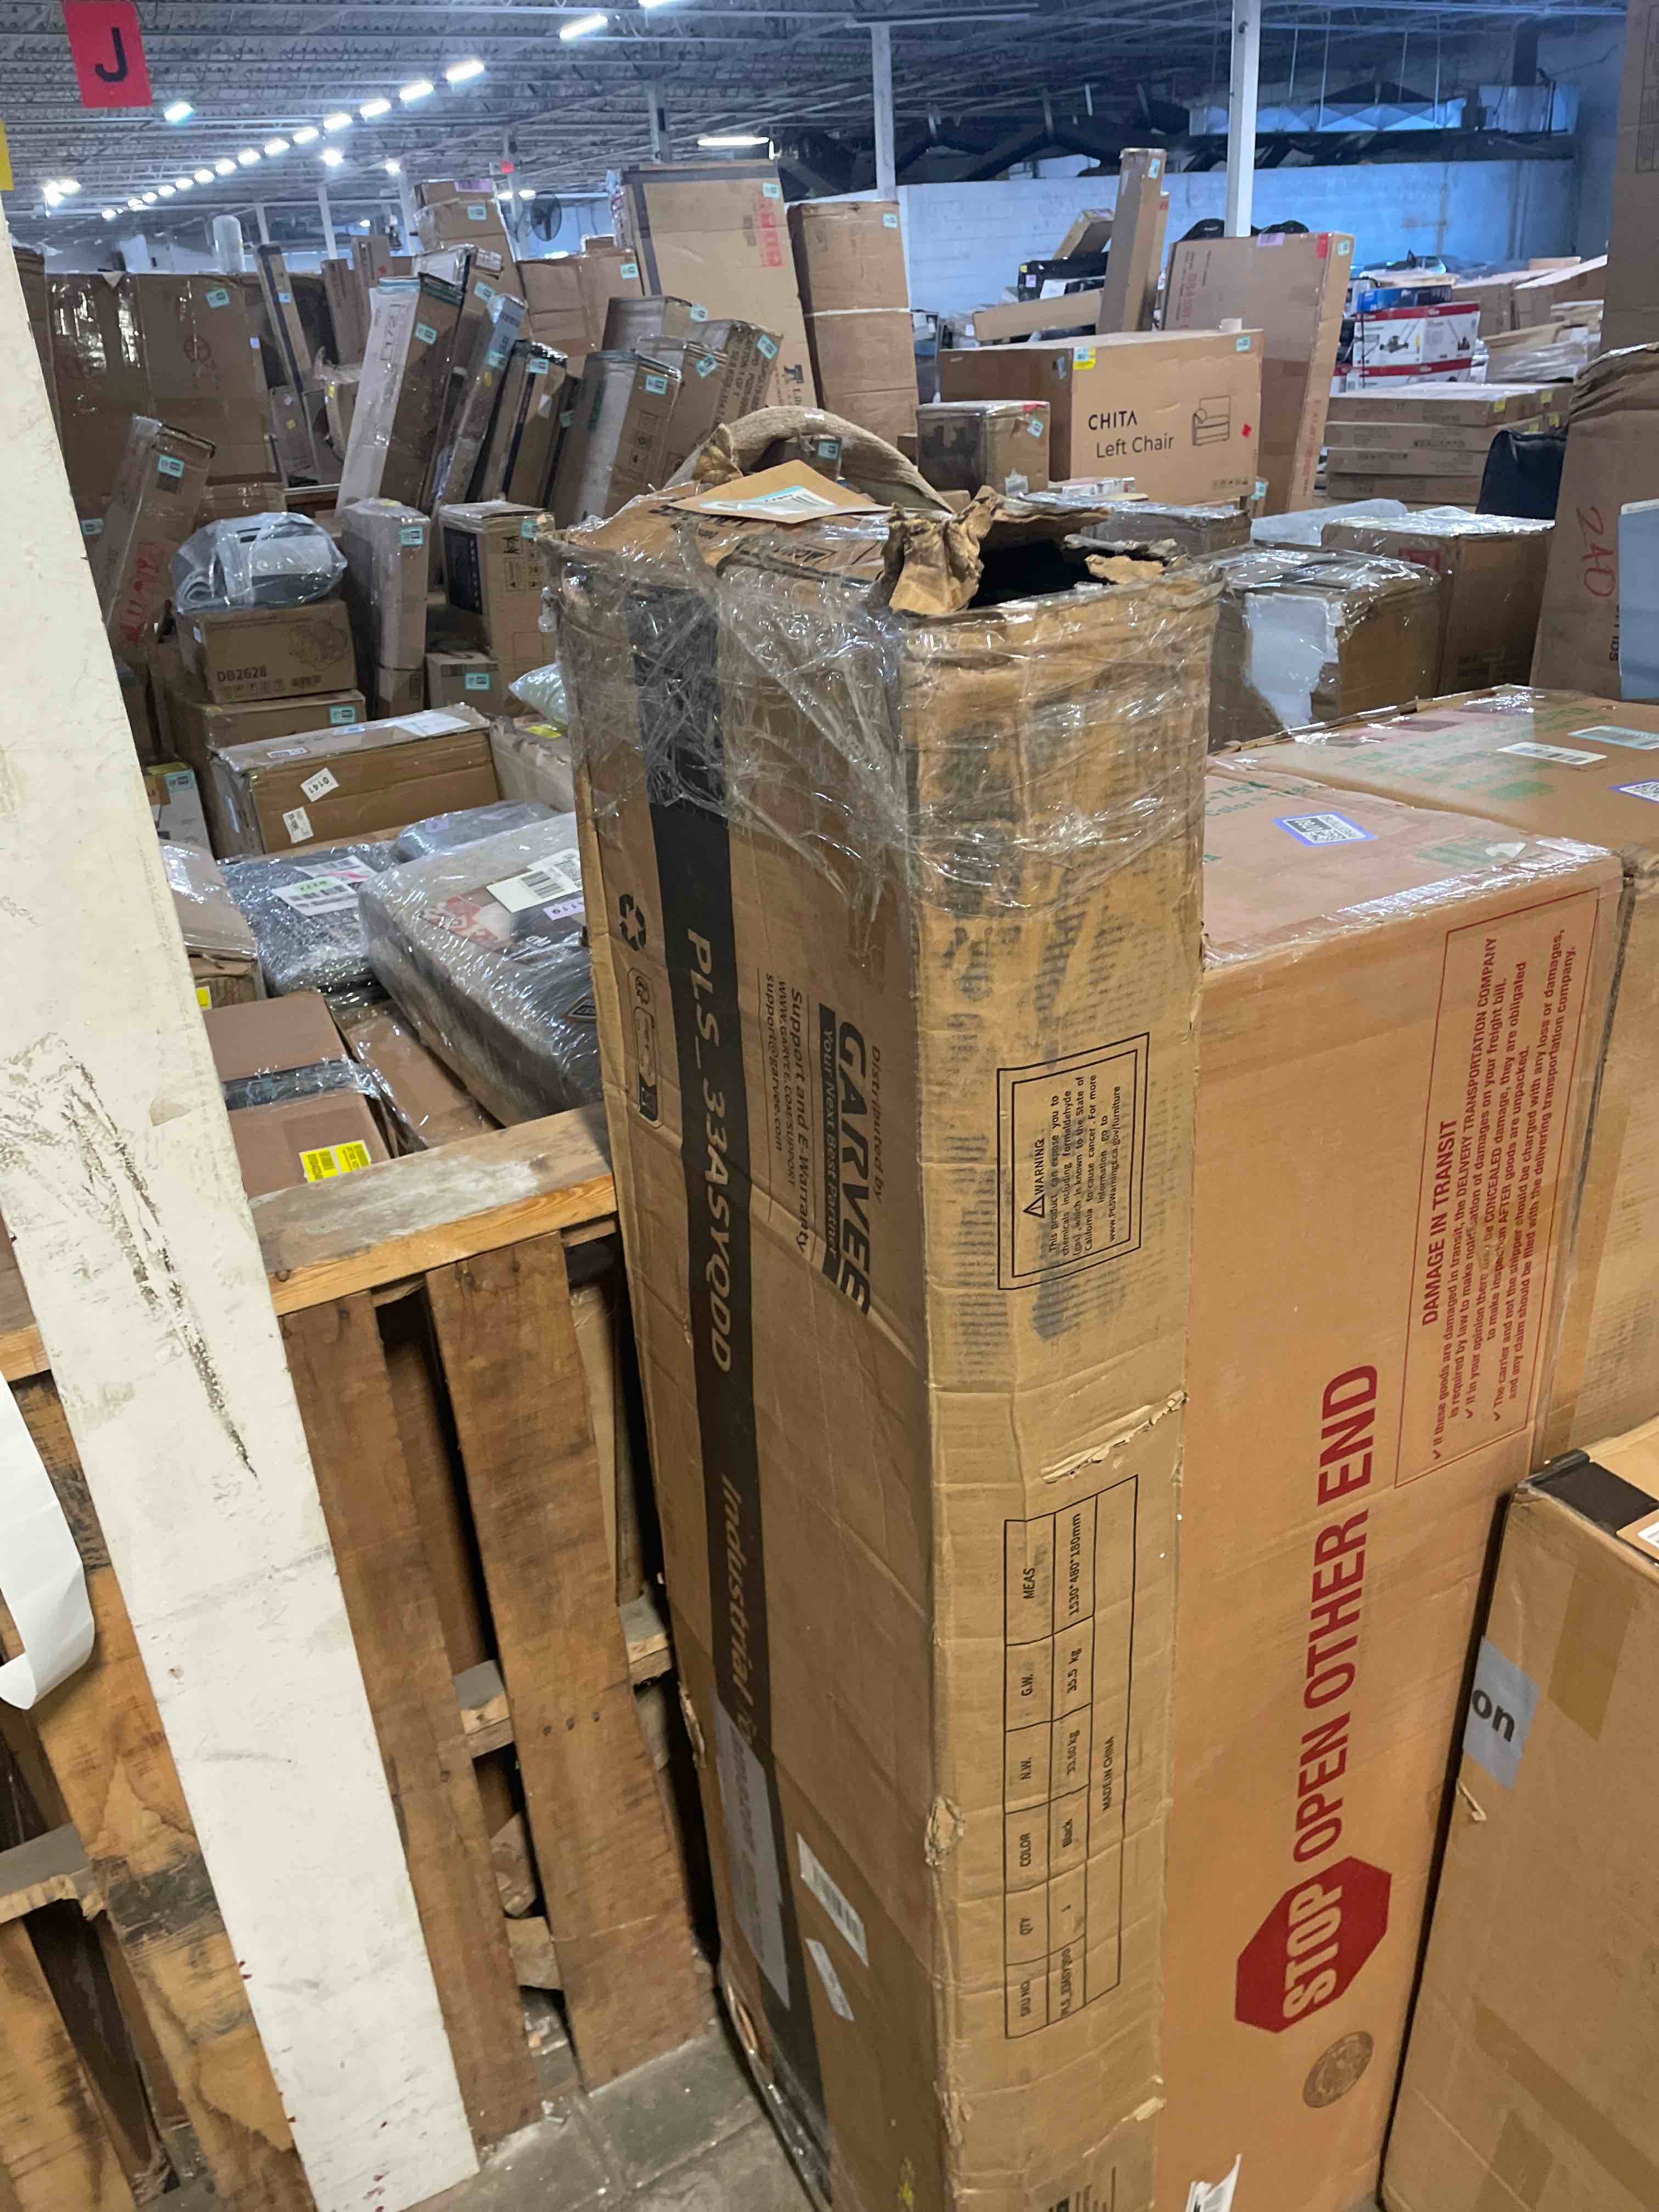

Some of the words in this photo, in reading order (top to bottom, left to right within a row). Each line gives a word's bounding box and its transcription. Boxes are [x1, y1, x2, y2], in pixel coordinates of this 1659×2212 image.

[94, 27, 128, 82] J
[1088, 410, 1137, 430] CHITA
[1097, 439, 1127, 458] Left
[1132, 433, 1174, 453] Chair
[217, 666, 268, 682] DB2628
[308, 776, 330, 794] 0141
[1477, 938, 1497, 1008] COMPANY
[1543, 929, 1565, 998] damages,
[1556, 946, 1577, 1013] company.
[1492, 978, 1507, 1003] bill.
[1509, 961, 1527, 1026] obligated
[1542, 1002, 1552, 1015] or
[790, 988, 808, 1080] Support
[1486, 1006, 1503, 1053] freight
[1505, 1030, 1517, 1052] are
[1536, 1019, 1550, 1048] loss
[764, 973, 783, 1152] support@garvee.com
[823, 1029, 835, 1076] Your
[1533, 1050, 1547, 1075] any
[1541, 1015, 1564, 1110] transportation
[778, 980, 795, 1188] WWW.GARVEE.COM/SUPPORT
[1076, 1076, 1085, 1086] of
[1463, 1011, 1488, 1133] TRANSPORTATION
[1482, 1058, 1497, 1087] your
[1500, 1057, 1515, 1084] they
[1511, 1045, 1531, 1114] unpacked.
[797, 1085, 808, 1131] and
[825, 1080, 836, 1127] Next
[1051, 1096, 1059, 1106] to
[1076, 1090, 1084, 1116] State
[1482, 1090, 1492, 1107] on
[1528, 1078, 1541, 1107] with
[871, 1045, 883, 1173] Distributed
[1051, 1110, 1060, 1128] you
[1062, 1091, 1073, 1156] formaldehyde
[1101, 1115, 1108, 1126] to
[1493, 1086, 1510, 1143] damage,
[1075, 1138, 1083, 1149] to
[1101, 1130, 1109, 1141] go
[1475, 1110, 1491, 1169] damages
[1509, 1118, 1519, 1138] are
[1520, 1110, 1537, 1162] charged
[1532, 1112, 1552, 1176] delivering
[826, 1133, 837, 1178] Best
[1034, 1138, 1045, 1195] WARNING
[1051, 1135, 1059, 1167] expose
[1108, 1086, 1121, 1243] www.P65Warnings.ca.gov/furniture
[1431, 1120, 1458, 1210] TRANSIT
[1455, 1136, 1474, 1197] DELIVERY
[1503, 1141, 1518, 1180] goods
[838, 1021, 870, 1314] GARVEE
[1051, 1172, 1059, 1187] can
[1074, 1154, 1082, 1186] known
[1098, 1150, 1107, 1203] information
[1471, 1171, 1482, 1183] of
[1519, 1164, 1531, 1182] be
[797, 1132, 810, 1253] E-Warranty
[873, 1176, 884, 1203] by
[1062, 1163, 1072, 1205] including
[1086, 1193, 1093, 1202] to
[1485, 1147, 1502, 1222] CONCEALED
[1530, 1178, 1543, 1199] the
[1049, 1194, 1059, 1229] product
[1454, 1200, 1466, 1221] the
[1498, 1183, 1512, 1224] AFTER
[1515, 1184, 1530, 1226] should
[1528, 1201, 1541, 1228] with
[827, 1182, 838, 1259] Partner
[1062, 1211, 1070, 1256] chemicals
[1085, 1208, 1093, 1251] California
[1430, 1212, 1449, 1236] IN
[1049, 1233, 1058, 1252] This
[1449, 1222, 1464, 1268] transit,
[1508, 1229, 1523, 1274] shipper
[1522, 1231, 1535, 1259] filed
[1421, 1238, 1445, 1326] DAMAGE
[1448, 1270, 1459, 1282] in
[1460, 1262, 1474, 1296] make
[1521, 1261, 1532, 1277] be
[1476, 1274, 1488, 1305] there
[1506, 1277, 1517, 1296] the
[1517, 1278, 1531, 1318] should
[1442, 1284, 1459, 1340] damaged
[1459, 1299, 1470, 1311] to
[1488, 1293, 1499, 1325] make
[1504, 1298, 1516, 1318] not
[1457, 1314, 1469, 1337] law
[1472, 1307, 1485, 1350] opinion
[1485, 1328, 1496, 1340] to
[1500, 1321, 1513, 1343] and
[1513, 1321, 1526, 1352] claim
[1442, 1343, 1451, 1362] are
[1455, 1339, 1468, 1352] by
[1451, 1356, 1465, 1405] required
[1469, 1353, 1482, 1379] your
[1497, 1346, 1510, 1383] carrier
[1511, 1355, 1524, 1375] any
[1437, 1364, 1451, 1400] goods
[1466, 1381, 1477, 1393] in
[1493, 1385, 1504, 1407] The
[1508, 1378, 1519, 1399] and
[1434, 1403, 1446, 1435] these
[1450, 1408, 1460, 1418] is
[1317, 1364, 1378, 1506] END
[721, 1474, 754, 1706] Industrial
[1023, 1567, 1036, 1599] MEAS
[1304, 1508, 1369, 1709] OTHER
[1068, 1649, 1082, 1663] kg
[1022, 1674, 1034, 1696] G.W.
[1066, 1668, 1079, 1694] 35.5
[1103, 1736, 1115, 1768] CHINA
[1021, 1757, 1032, 1781] N.W.
[1293, 1711, 1351, 1863] OPEN
[1062, 1818, 1073, 1848] Black
[1020, 1832, 1032, 1867] COLOR
[1020, 1916, 1033, 1936] QTY
[1282, 1883, 1343, 2019] STOP
